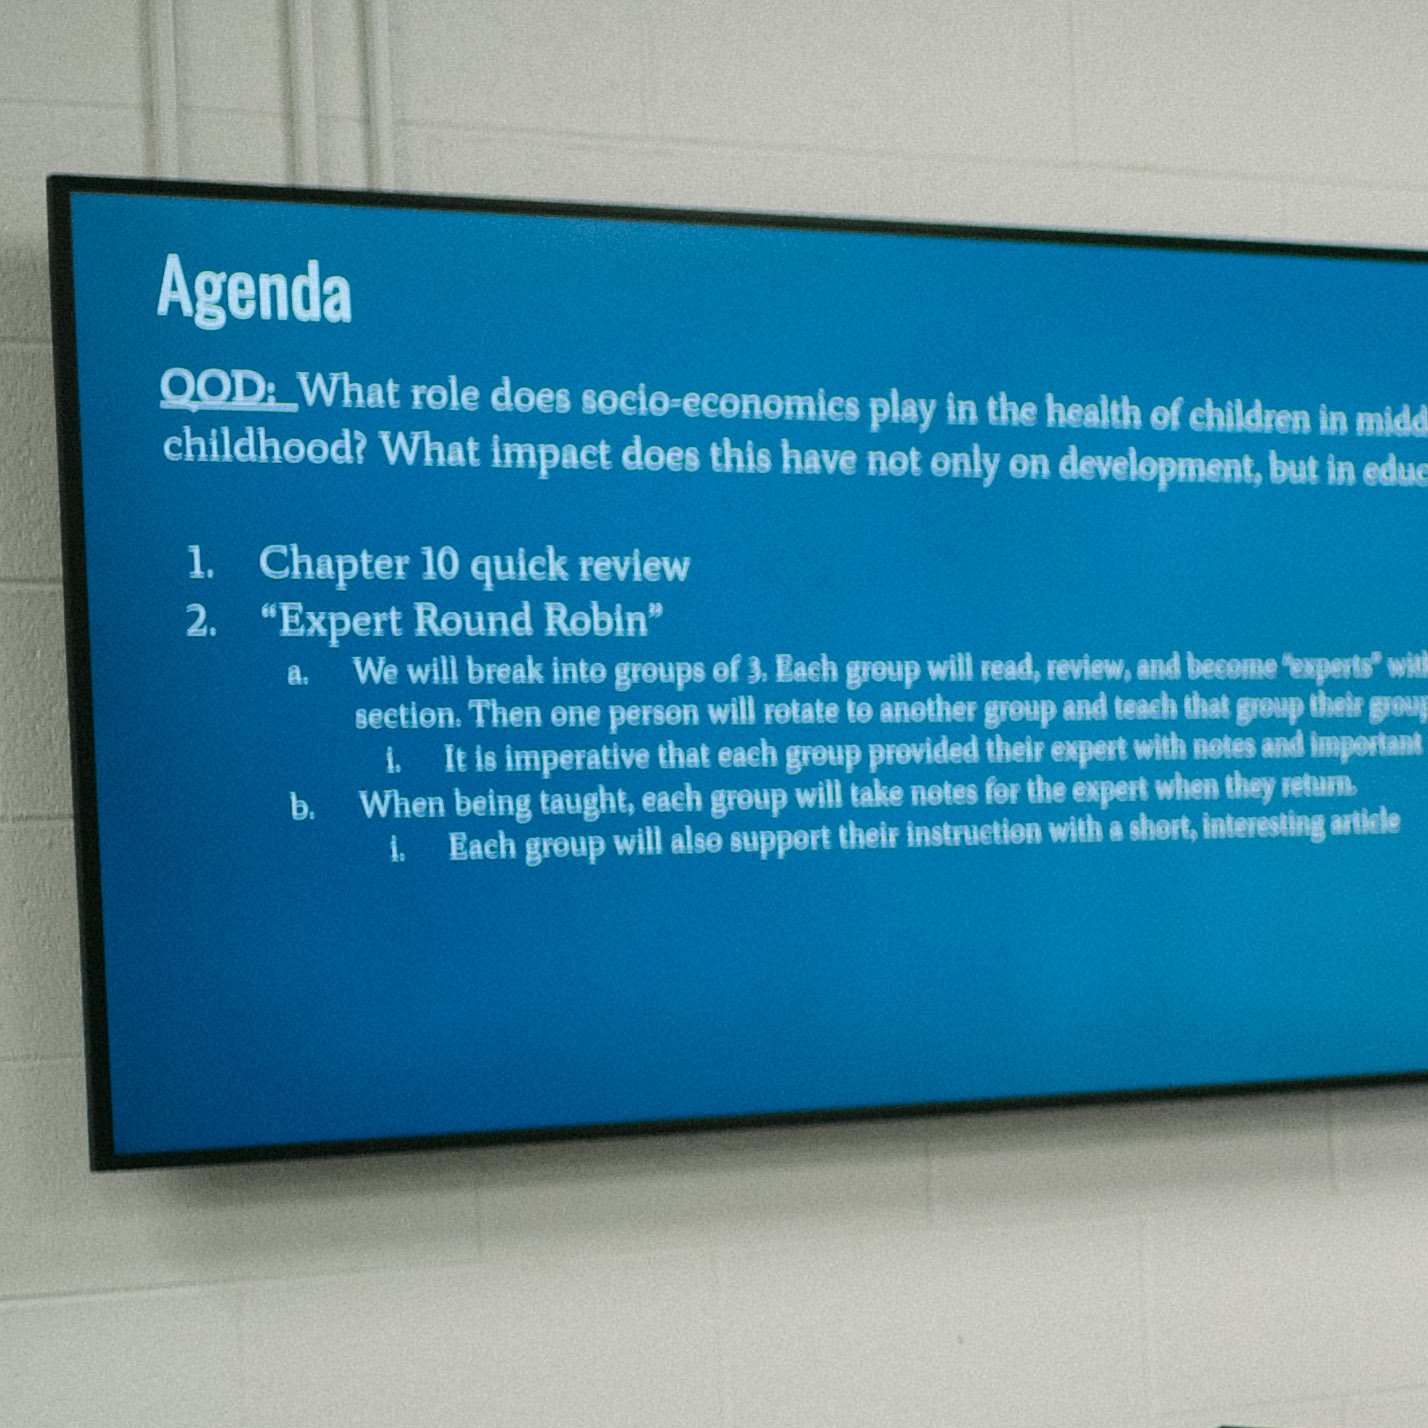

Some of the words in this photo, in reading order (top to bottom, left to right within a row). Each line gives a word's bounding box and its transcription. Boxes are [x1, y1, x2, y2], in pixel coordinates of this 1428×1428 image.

[157, 253, 352, 330] Agenda
[160, 367, 292, 415] QOD:
[299, 369, 401, 412] What
[412, 375, 481, 412] role
[491, 376, 572, 413] does
[582, 383, 860, 421] socio-economics
[870, 387, 937, 433] play
[947, 391, 978, 425] in
[987, 391, 1037, 426] the
[1045, 392, 1142, 430] health
[1150, 396, 1184, 431] of
[1189, 397, 1311, 434] children
[1319, 403, 1348, 435] in
[163, 425, 367, 464] childhood?
[378, 430, 481, 467] What
[491, 433, 612, 480] impact
[621, 435, 701, 472] does
[710, 437, 773, 473] this
[780, 438, 857, 475] have
[866, 447, 922, 476] not
[930, 443, 1001, 488] only
[1009, 454, 1051, 480] on
[1059, 445, 1263, 492] development,
[1269, 450, 1320, 485] but
[1327, 453, 1357, 486] in
[188, 544, 214, 579] 1.
[260, 543, 410, 590] Chapter
[421, 545, 460, 580] 10
[470, 545, 569, 591] quick
[579, 548, 691, 582] review
[186, 603, 216, 637] 2.
[413, 601, 534, 637] Round
[288, 665, 308, 685] a.
[352, 656, 398, 684] We
[407, 655, 458, 685] will
[466, 655, 544, 684] break
[552, 657, 607, 684] into
[615, 662, 706, 691] groups
[712, 653, 742, 683] of
[747, 656, 767, 684] 3.
[775, 653, 838, 682] Each
[846, 660, 921, 689] group
[927, 652, 973, 681] will
[981, 651, 1041, 682] read,
[1047, 653, 1132, 682] review,
[1136, 651, 1181, 680] and
[1186, 651, 1278, 679] become
[355, 701, 461, 729] section.
[468, 699, 542, 728] Then
[551, 705, 601, 727] one
[609, 704, 699, 734] person
[707, 695, 756, 725] will
[764, 699, 840, 724] rotate
[847, 698, 874, 723] to
[880, 694, 978, 723] another
[984, 699, 1057, 729] group
[1063, 692, 1108, 721] and
[1114, 691, 1178, 720] teach
[1184, 692, 1231, 719] that
[1236, 697, 1304, 725] group
[1309, 691, 1364, 717] their
[386, 746, 401, 773] i.
[445, 744, 467, 772] It
[475, 745, 497, 772] is
[505, 742, 650, 776] imperative
[658, 740, 710, 768] that
[718, 738, 778, 768] each
[786, 744, 862, 772] group
[868, 735, 980, 771] provided
[986, 735, 1045, 763] their
[1050, 736, 1128, 767] expert
[1133, 732, 1188, 760] with
[1193, 736, 1256, 759] notes
[1262, 730, 1305, 758] and
[1310, 732, 1424, 763] important
[290, 792, 315, 820] b.
[358, 789, 445, 818] When
[454, 788, 533, 820] being
[540, 784, 635, 819] taught,
[642, 783, 702, 812] each
[710, 788, 788, 817] group
[795, 779, 843, 808] will
[851, 778, 904, 807] take
[910, 781, 979, 806] notes
[985, 776, 1021, 804] for
[1027, 775, 1067, 804] the
[1072, 777, 1149, 809] expert
[1154, 772, 1220, 800] when
[1225, 771, 1276, 804] they
[1282, 774, 1358, 797] return.
[390, 835, 405, 862] i.
[449, 830, 517, 861] Each
[525, 836, 606, 865] group
[613, 826, 663, 856] will
[671, 825, 723, 854] also
[730, 825, 831, 859] support
[839, 820, 900, 849] their
[906, 818, 1043, 847] instruction
[1048, 814, 1104, 843] with
[1109, 821, 1124, 842] a
[1129, 813, 1198, 842] short,
[1202, 813, 1327, 844] interesting
[1330, 805, 1401, 835] article
